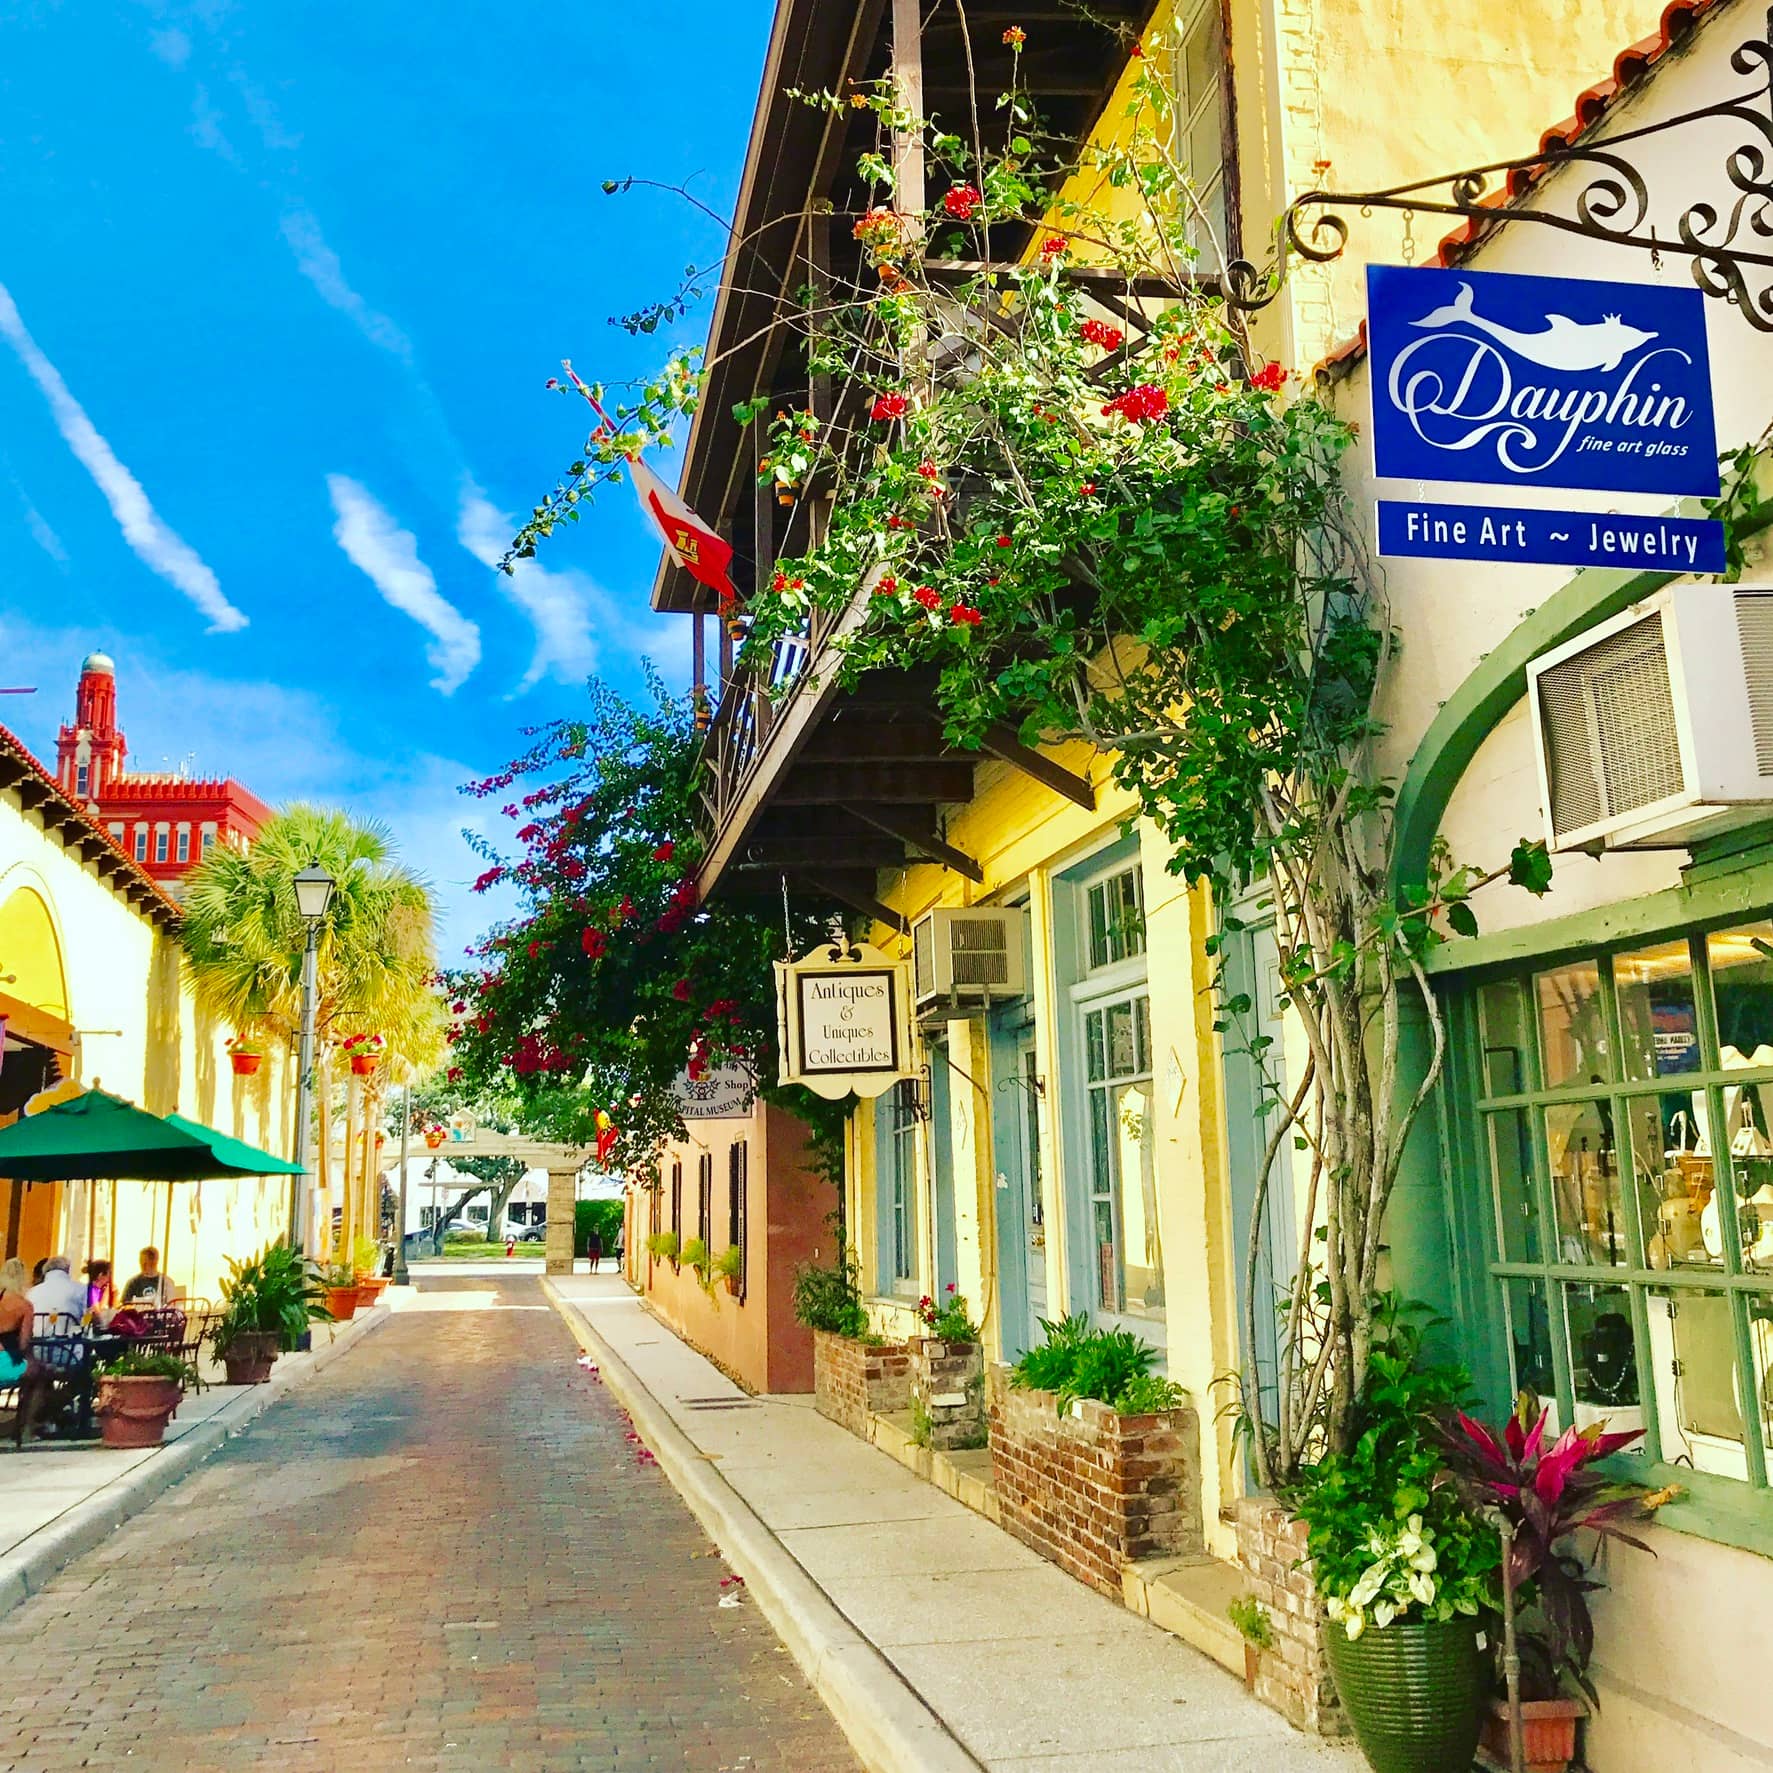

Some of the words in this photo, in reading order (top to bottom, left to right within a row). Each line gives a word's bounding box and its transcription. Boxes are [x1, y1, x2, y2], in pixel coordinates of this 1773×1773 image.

[1388, 333, 1693, 473] Dauphin
[1576, 435, 1613, 453] fine
[1617, 440, 1643, 453] art
[1644, 440, 1689, 457] glass
[1407, 512, 1466, 544] Fine
[1480, 517, 1526, 547] Art
[1589, 523, 1698, 564] Jewelry
[811, 982, 884, 1004] Antiques
[840, 1005, 854, 1021] &
[823, 1024, 874, 1043] Uniques
[809, 1048, 889, 1065] Collectibles
[725, 1080, 749, 1092] Shop
[706, 1097, 741, 1116] MUSEUM
